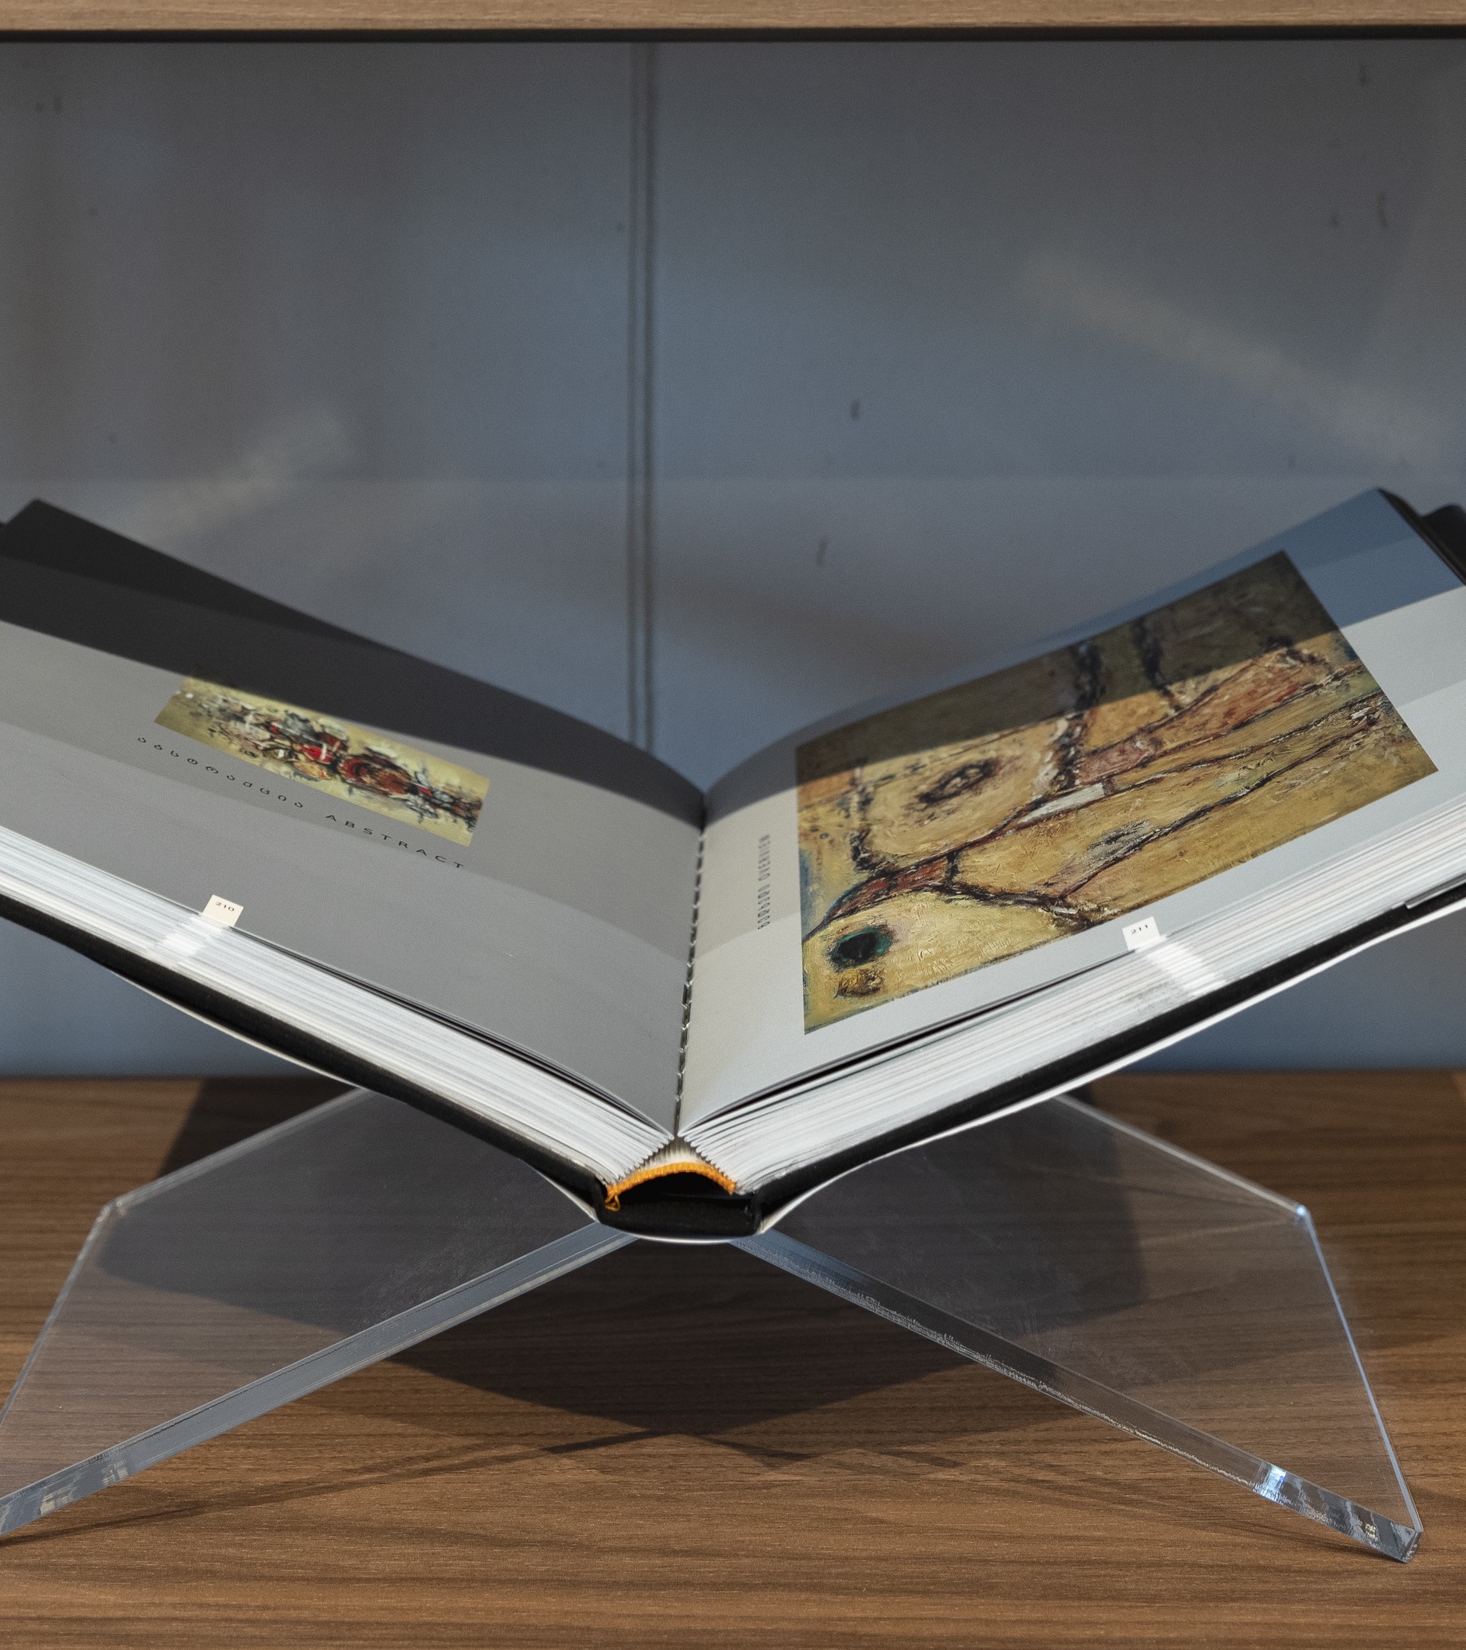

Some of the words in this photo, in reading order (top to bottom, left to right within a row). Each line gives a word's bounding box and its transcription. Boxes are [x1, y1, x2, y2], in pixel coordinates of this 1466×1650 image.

[325, 814, 465, 869] ABSTRACT
[215, 901, 235, 912] 210
[1131, 924, 1149, 935] 211
